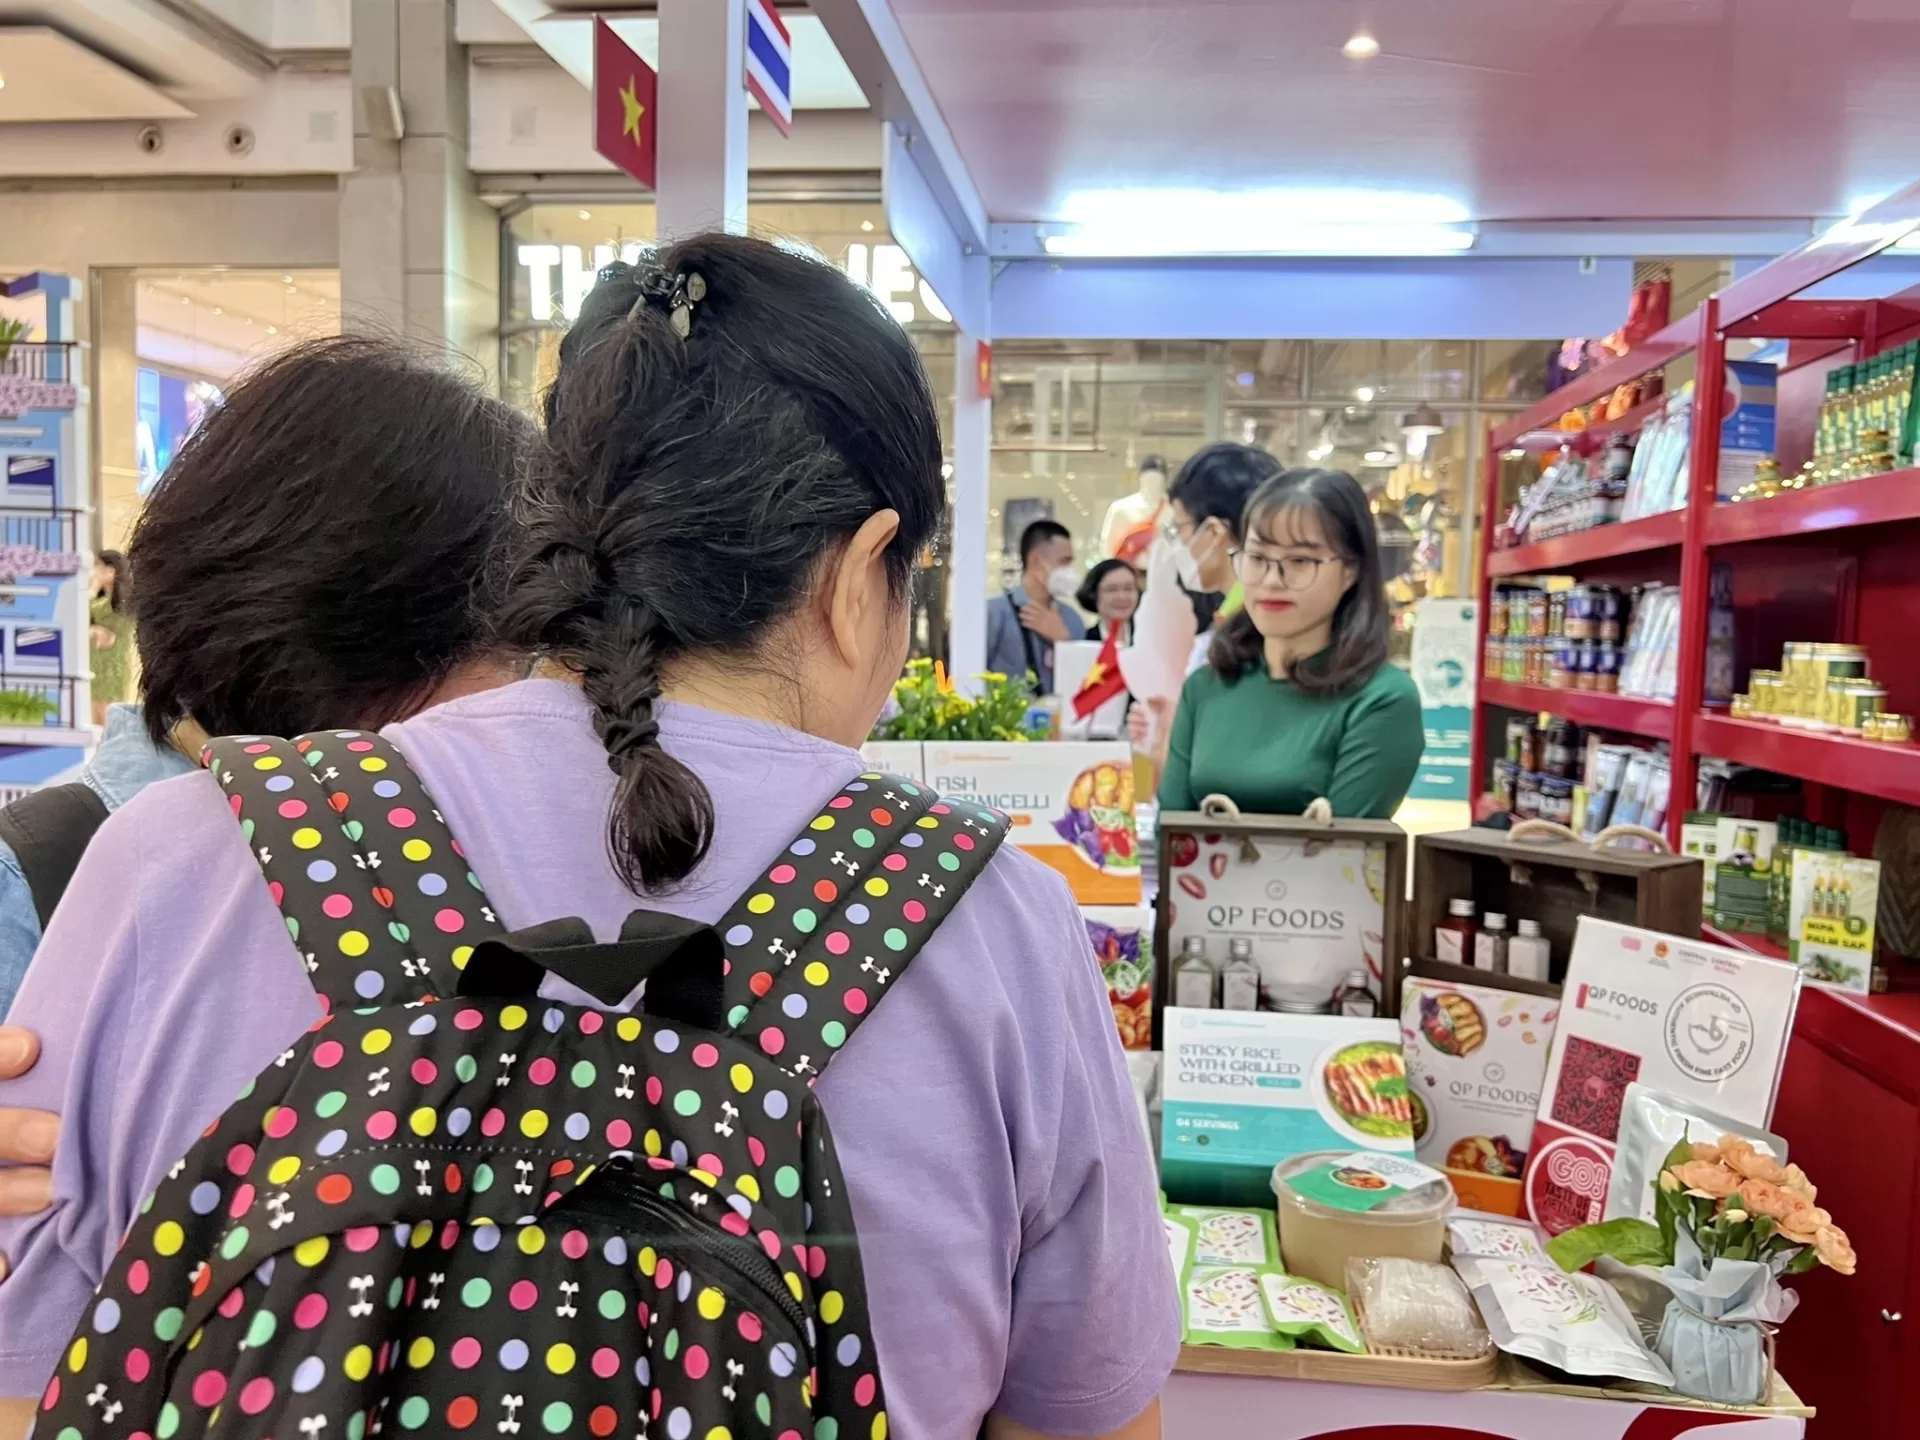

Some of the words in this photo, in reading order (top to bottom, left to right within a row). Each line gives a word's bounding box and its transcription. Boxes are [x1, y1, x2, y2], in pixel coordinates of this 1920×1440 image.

[935, 776, 978, 792] FISH
[1206, 904, 1244, 929] QP
[1252, 907, 1345, 932] FOODS
[1588, 985, 1608, 1000] QP
[1608, 990, 1660, 1016] FOODS
[1179, 1043, 1238, 1057] STICKY
[1242, 1046, 1284, 1060] RICE
[1731, 1040, 1747, 1065] FOOD
[1179, 1056, 1226, 1071] WITH
[1230, 1059, 1302, 1075] GRILLED
[1178, 1071, 1255, 1087] CHICKEN
[1449, 1080, 1473, 1096] QP
[1477, 1084, 1539, 1106] FOODS
[1547, 1148, 1609, 1201] GO!
